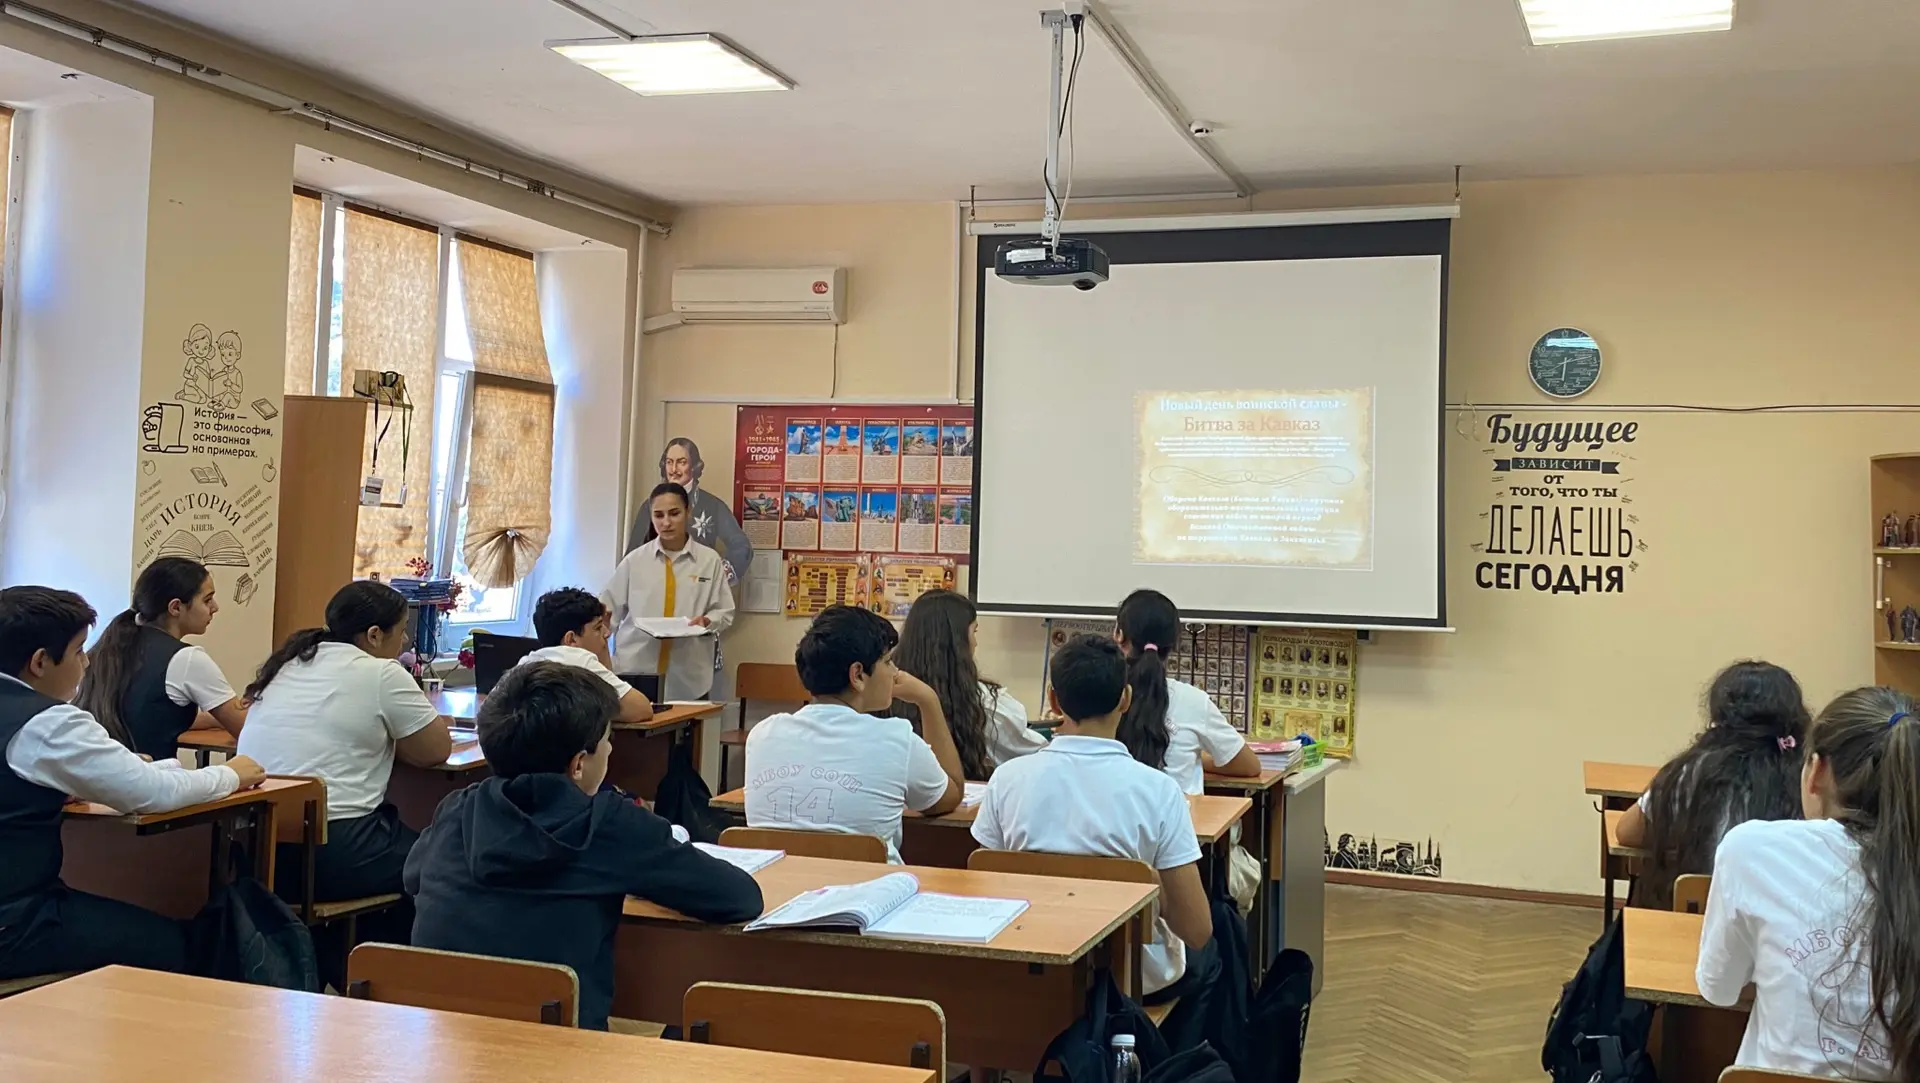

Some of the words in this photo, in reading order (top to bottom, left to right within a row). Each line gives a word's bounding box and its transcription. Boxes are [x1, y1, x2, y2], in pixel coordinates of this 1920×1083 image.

[1161, 397, 1203, 412] Новый
[1204, 401, 1234, 411] день
[194, 407, 235, 421] История
[193, 421, 211, 430] это
[213, 422, 273, 437] философия,
[1184, 416, 1233, 431] Битва
[1238, 420, 1255, 431] за
[1260, 416, 1321, 431] Кавказ
[192, 433, 251, 445] основанная
[1487, 413, 1639, 453] Будущее
[192, 445, 205, 454] на
[207, 446, 258, 459] примерах.
[746, 446, 783, 454] ГОРОДА-
[1518, 460, 1594, 470] ЗАВИСИТ
[160, 492, 241, 527] ИСТОРИЯ
[191, 523, 215, 532] КНЯЗЬ
[1485, 504, 1633, 558] ДЕЛАЕШЬ
[1475, 562, 1624, 594] СЕГОДНЯ
[753, 764, 805, 790] МБОУ
[767, 786, 835, 824] 14
